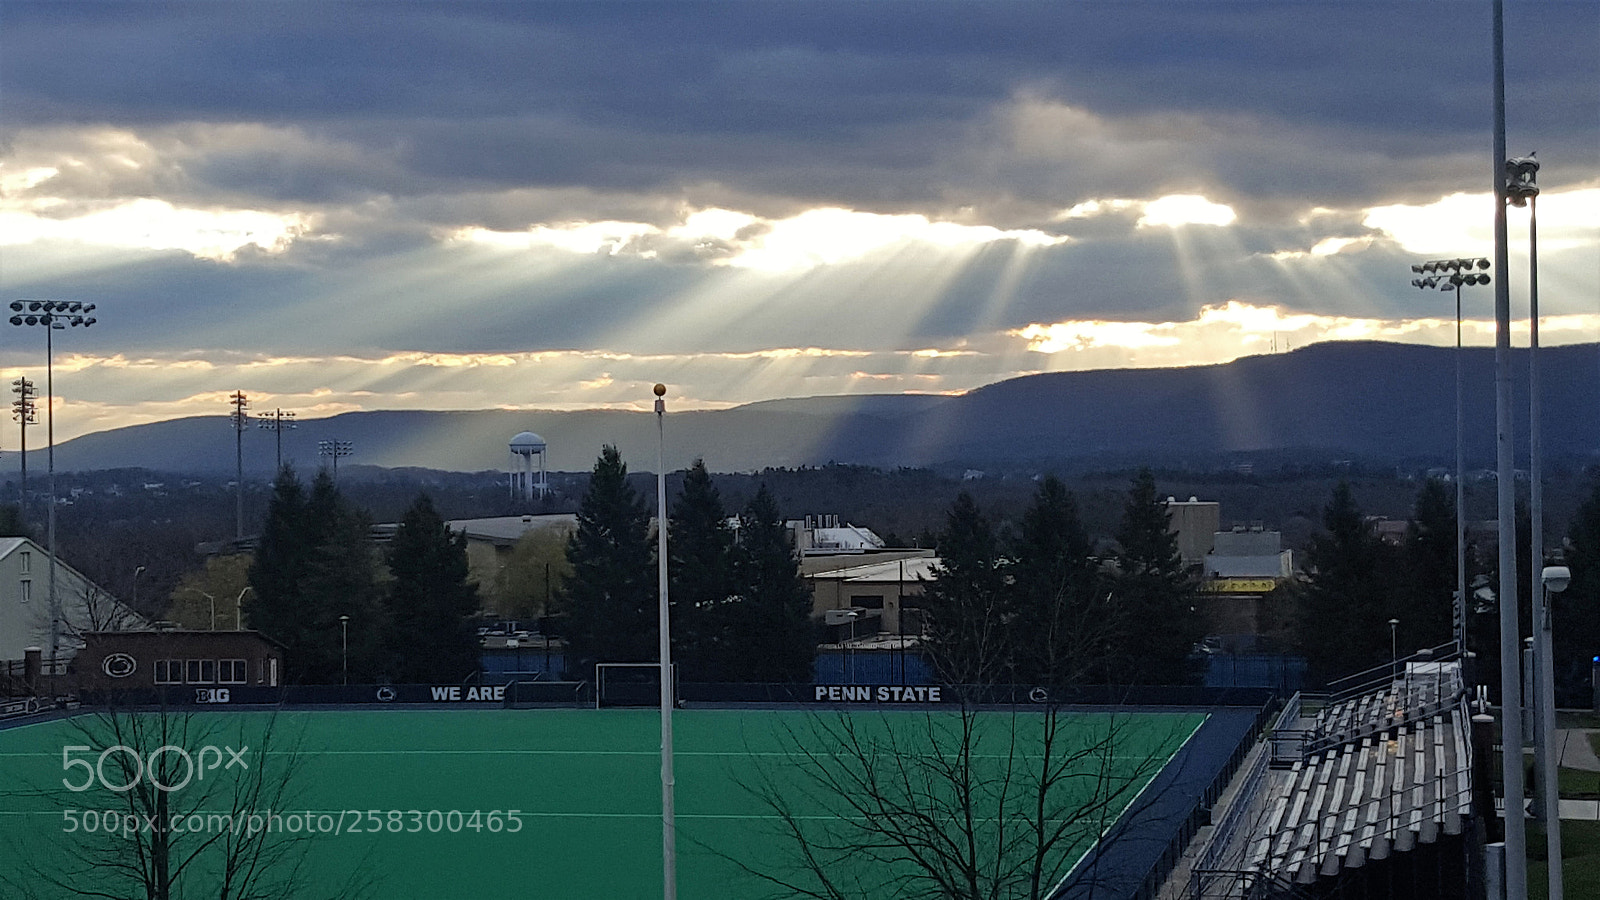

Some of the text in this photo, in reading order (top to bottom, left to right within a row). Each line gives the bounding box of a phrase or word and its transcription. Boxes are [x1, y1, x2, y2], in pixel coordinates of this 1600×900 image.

[431, 686, 506, 701] WE ARE
[815, 686, 941, 702] PENN STATE
